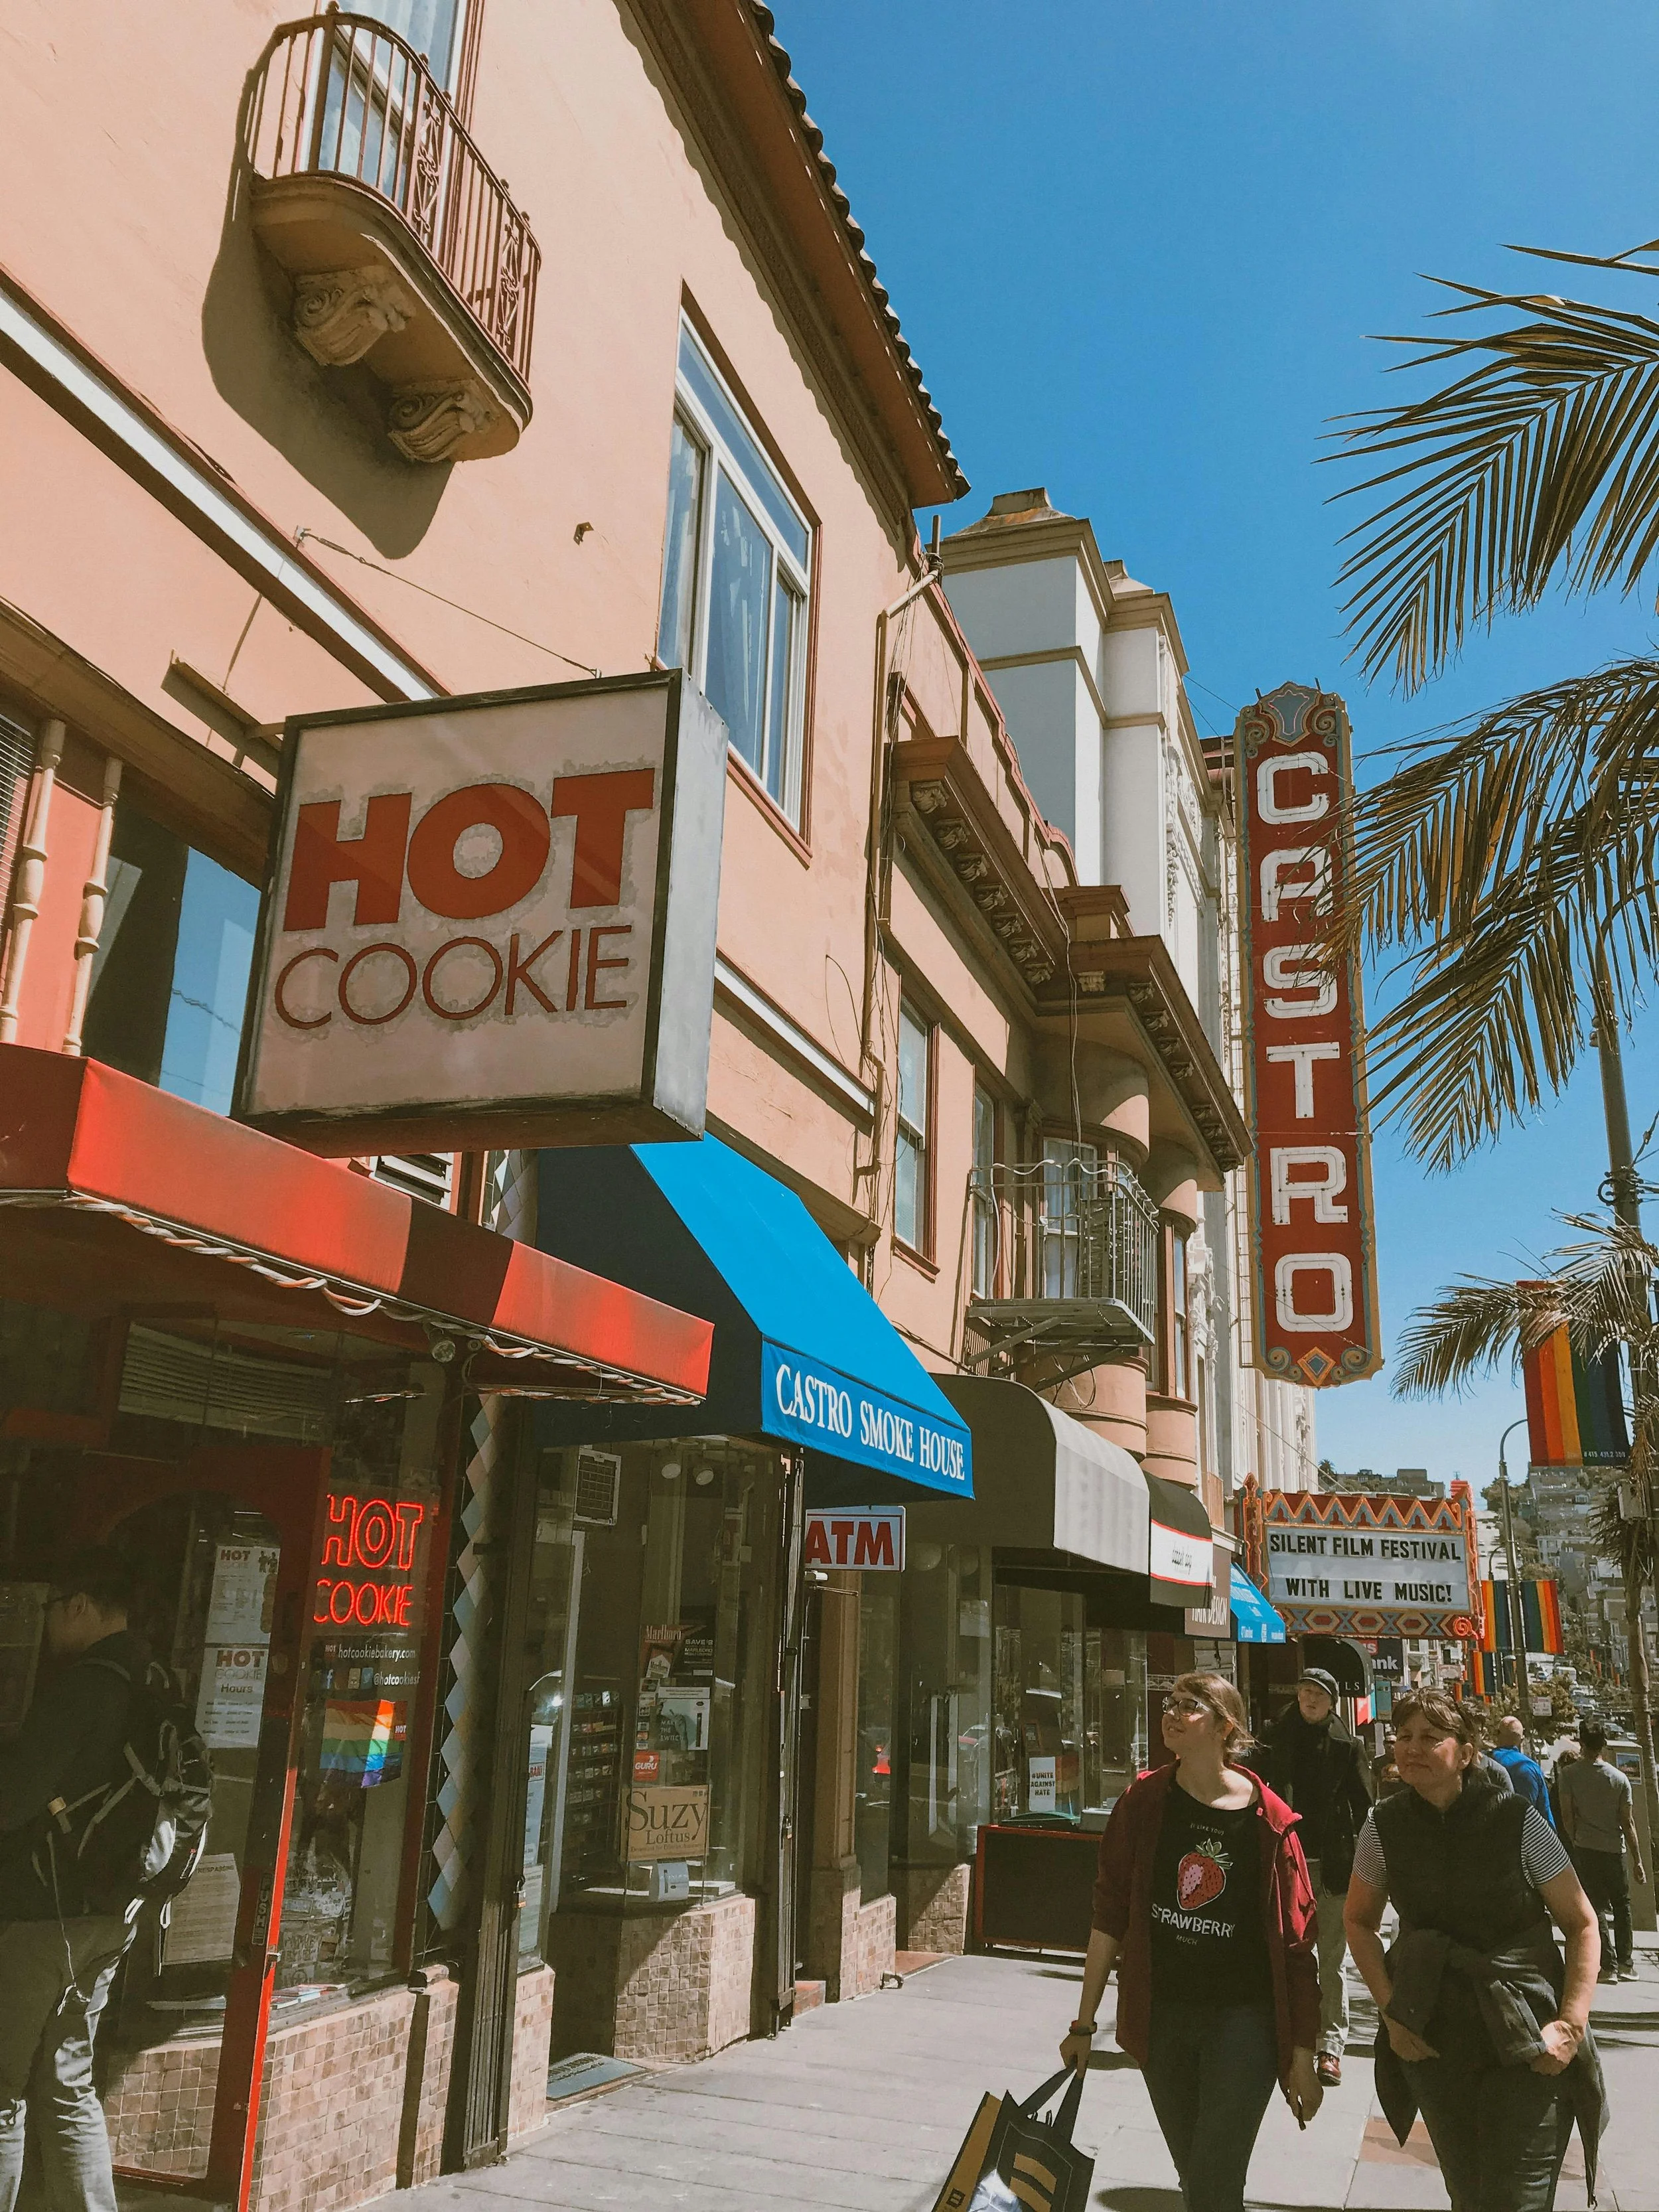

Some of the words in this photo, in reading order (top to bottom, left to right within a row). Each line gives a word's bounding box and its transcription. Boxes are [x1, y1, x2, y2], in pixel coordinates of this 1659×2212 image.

[283, 768, 655, 931] HOT
[275, 925, 632, 1029] COOKIE
[1257, 751, 1353, 1333] CASTRO
[776, 1364, 852, 1438] CASTRO
[860, 1400, 914, 1463] SMOKE
[919, 1426, 965, 1481] HOUSE
[321, 1495, 425, 1571] HOT
[805, 1520, 895, 1566] ATM
[220, 1550, 251, 1562] HOT
[1270, 1534, 1327, 1554] SILENT
[1333, 1538, 1374, 1556] FILM
[1381, 1539, 1461, 1560] FESTIVAL
[313, 1578, 414, 1626] COOKIE
[1285, 1578, 1329, 1597] WITH
[1344, 1580, 1382, 1599] LIVE
[1395, 1582, 1452, 1602] MUSIC!
[646, 1624, 682, 1640] Marlboro
[216, 1651, 265, 1668] HOT
[338, 1644, 415, 1662] hotcookiebakery.com
[215, 1669, 262, 1680] COOKIE
[221, 1684, 253, 1693] Hours
[625, 1791, 709, 1840] Suzy
[646, 1828, 690, 1844] Loftus
[1151, 1903, 1236, 1937] STRAWBERRY
[1176, 1935, 1198, 1945] MUCH
